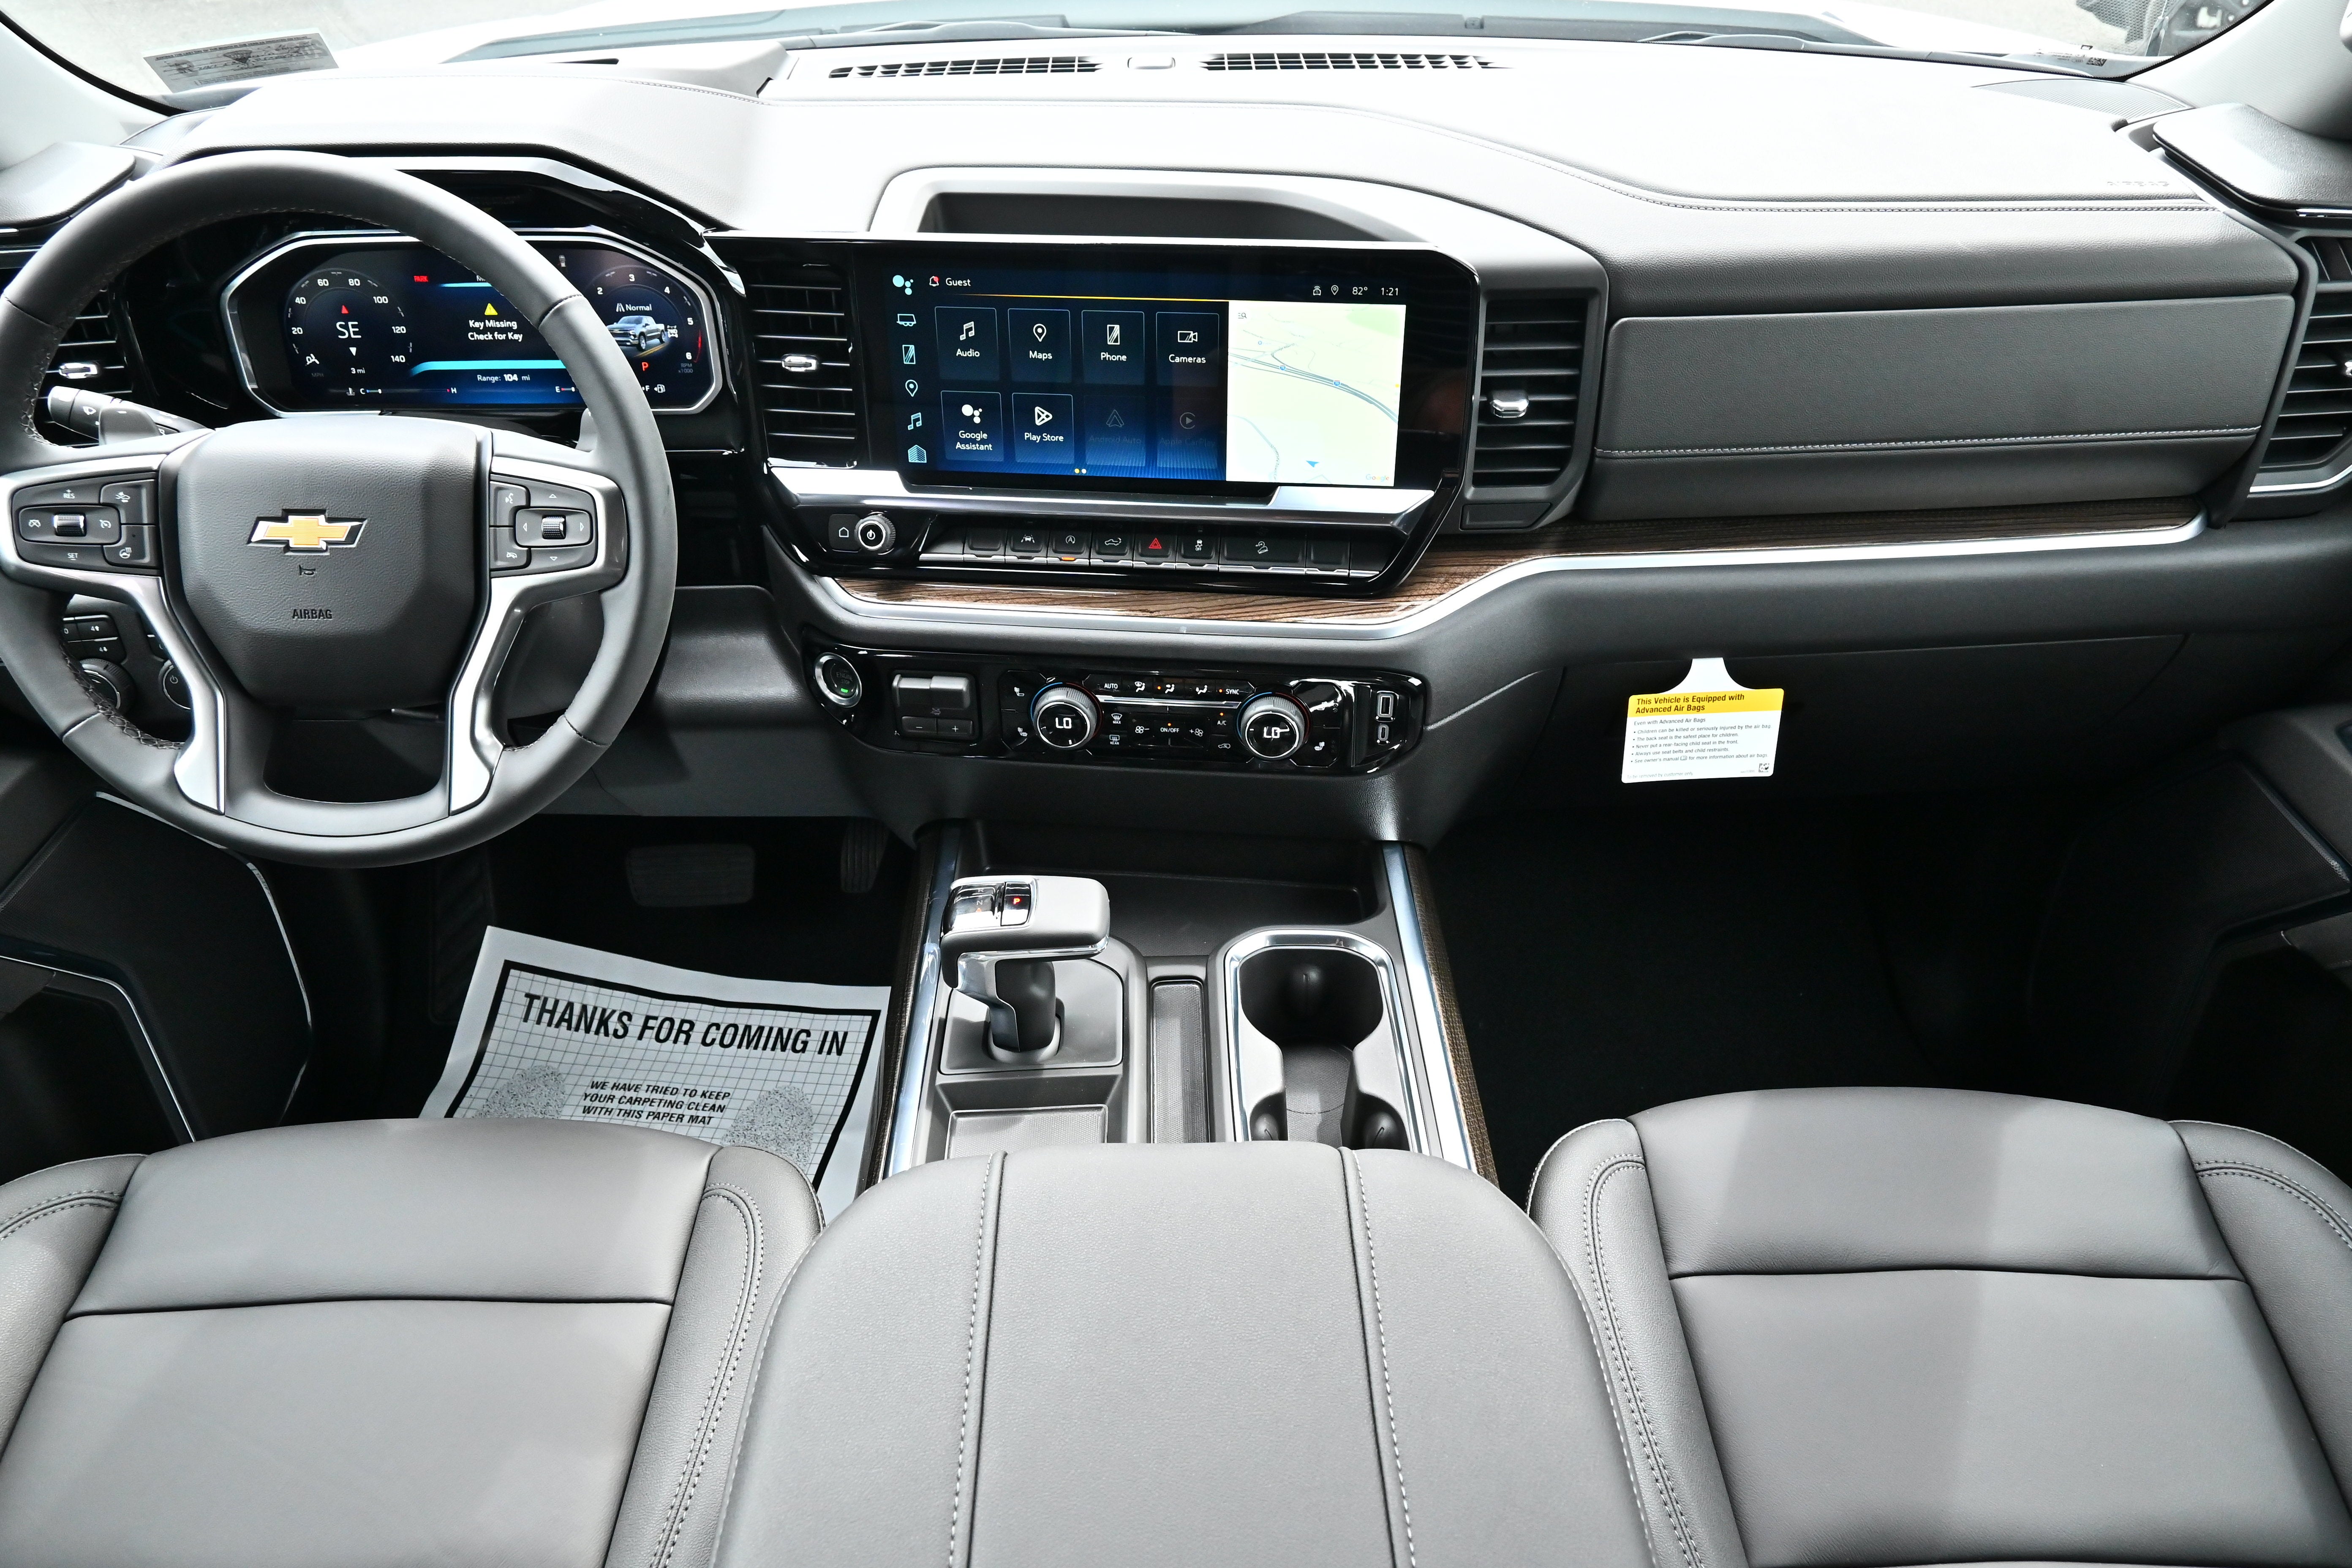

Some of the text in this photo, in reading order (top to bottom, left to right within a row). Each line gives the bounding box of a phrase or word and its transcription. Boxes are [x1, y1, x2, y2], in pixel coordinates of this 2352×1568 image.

[945, 278, 971, 286] Guest
[1353, 287, 1368, 295] 82°
[469, 320, 517, 329] Key Missing
[336, 321, 362, 338] SE
[468, 332, 493, 340] Check
[508, 332, 523, 342] Key
[956, 349, 980, 357] Audio
[1029, 351, 1052, 361] Maps
[1101, 352, 1127, 362] Phone
[1169, 354, 1206, 363] Cameras
[642, 362, 649, 371] P
[959, 431, 988, 440] Google
[1024, 433, 1064, 443] Play Store
[1089, 436, 1141, 444] Android Auto
[956, 442, 992, 451] Assistant
[1366, 474, 1389, 482] Google
[292, 609, 332, 619] AIRBAG
[1692, 694, 1726, 703] Equipped
[1636, 705, 1671, 714] Advanced
[1056, 717, 1072, 729] LO
[524, 993, 848, 1056] THANKS FOR COMING IN
[591, 1081, 731, 1100] WE HAVE TRIED TO KEEP
[583, 1092, 726, 1113] YOUR CARPETING CLEAN
[582, 1105, 714, 1125] WITH THIS PAPER MAT
